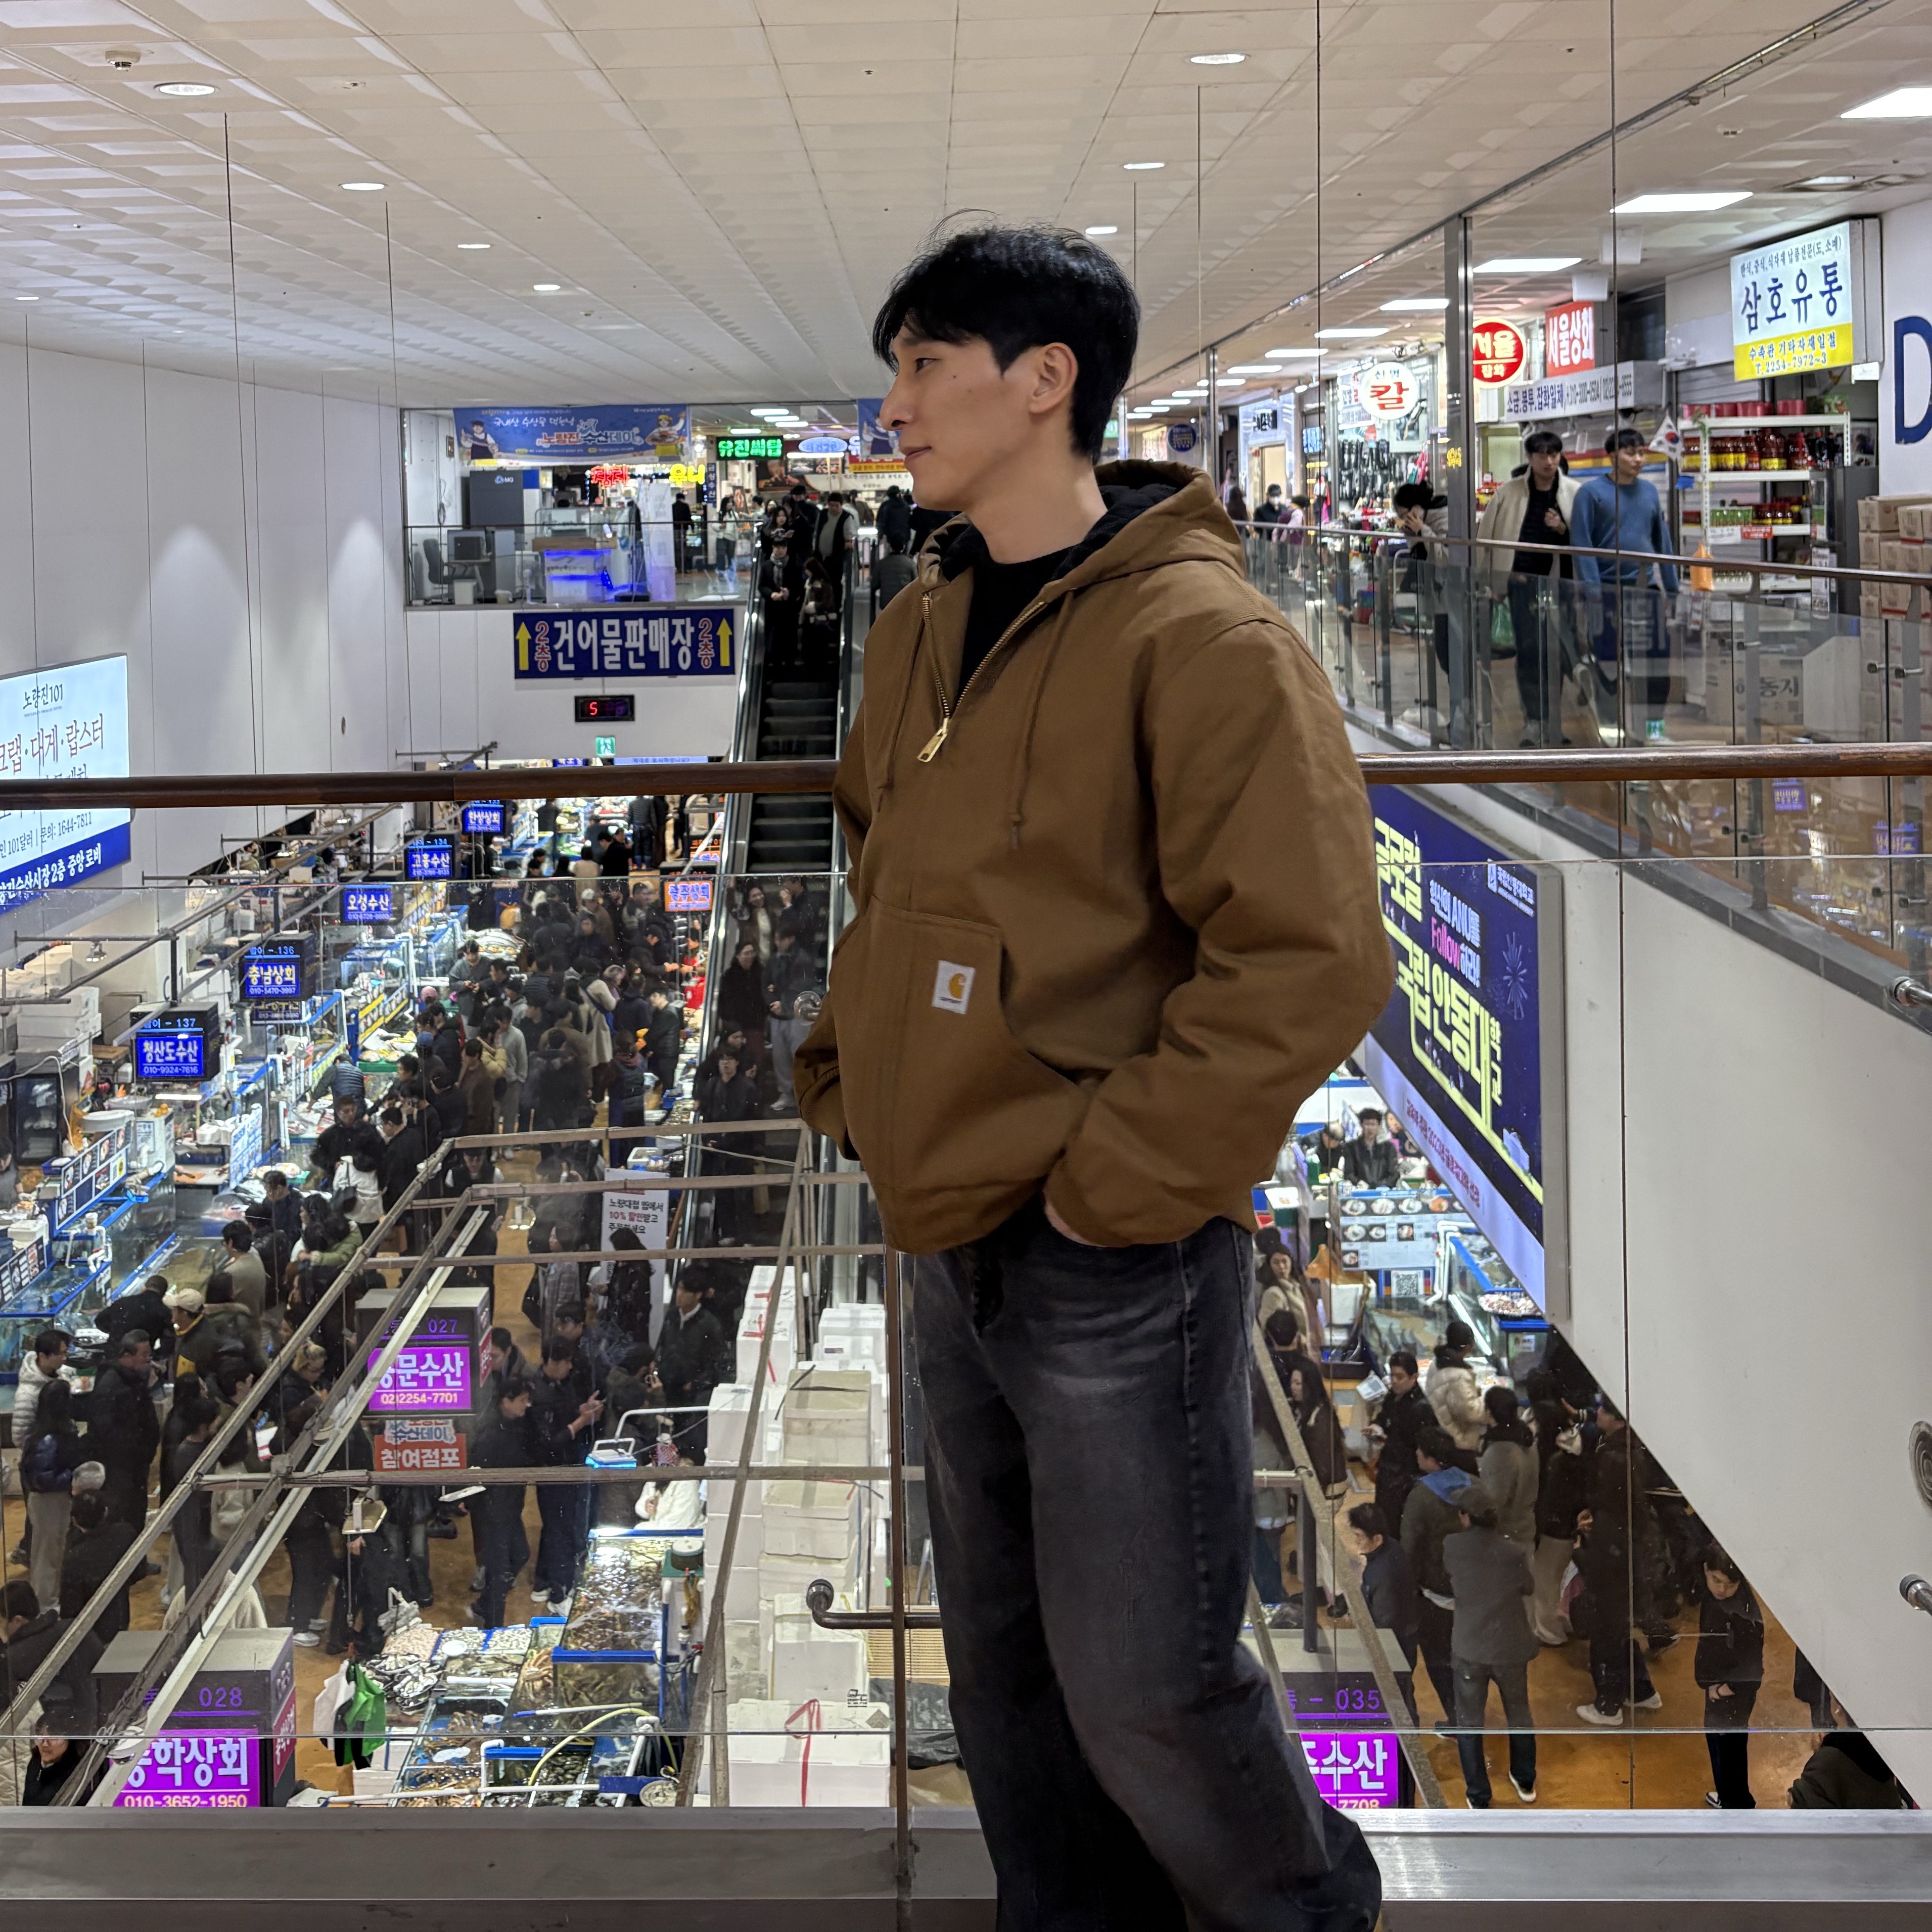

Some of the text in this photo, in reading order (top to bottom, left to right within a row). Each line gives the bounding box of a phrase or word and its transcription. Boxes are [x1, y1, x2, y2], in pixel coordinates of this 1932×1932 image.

[1741, 261, 1843, 335] 삼호유통
[1548, 306, 1594, 367] 서울상회
[1370, 381, 1409, 410] 칼
[534, 617, 715, 672] 2층 건어물판매장 2층
[23, 683, 63, 710] 노량진101
[58, 812, 93, 837] 1644-7811
[347, 894, 389, 912] 오성수산
[278, 946, 295, 955] 136
[249, 965, 296, 986] 충남상회
[176, 1018, 196, 1028] 137
[143, 1040, 198, 1063] 청산도수산
[429, 1319, 457, 1333] 027
[381, 1447, 461, 1469] 참여점포
[199, 1687, 243, 1708] 028
[1337, 1689, 1380, 1711] 035
